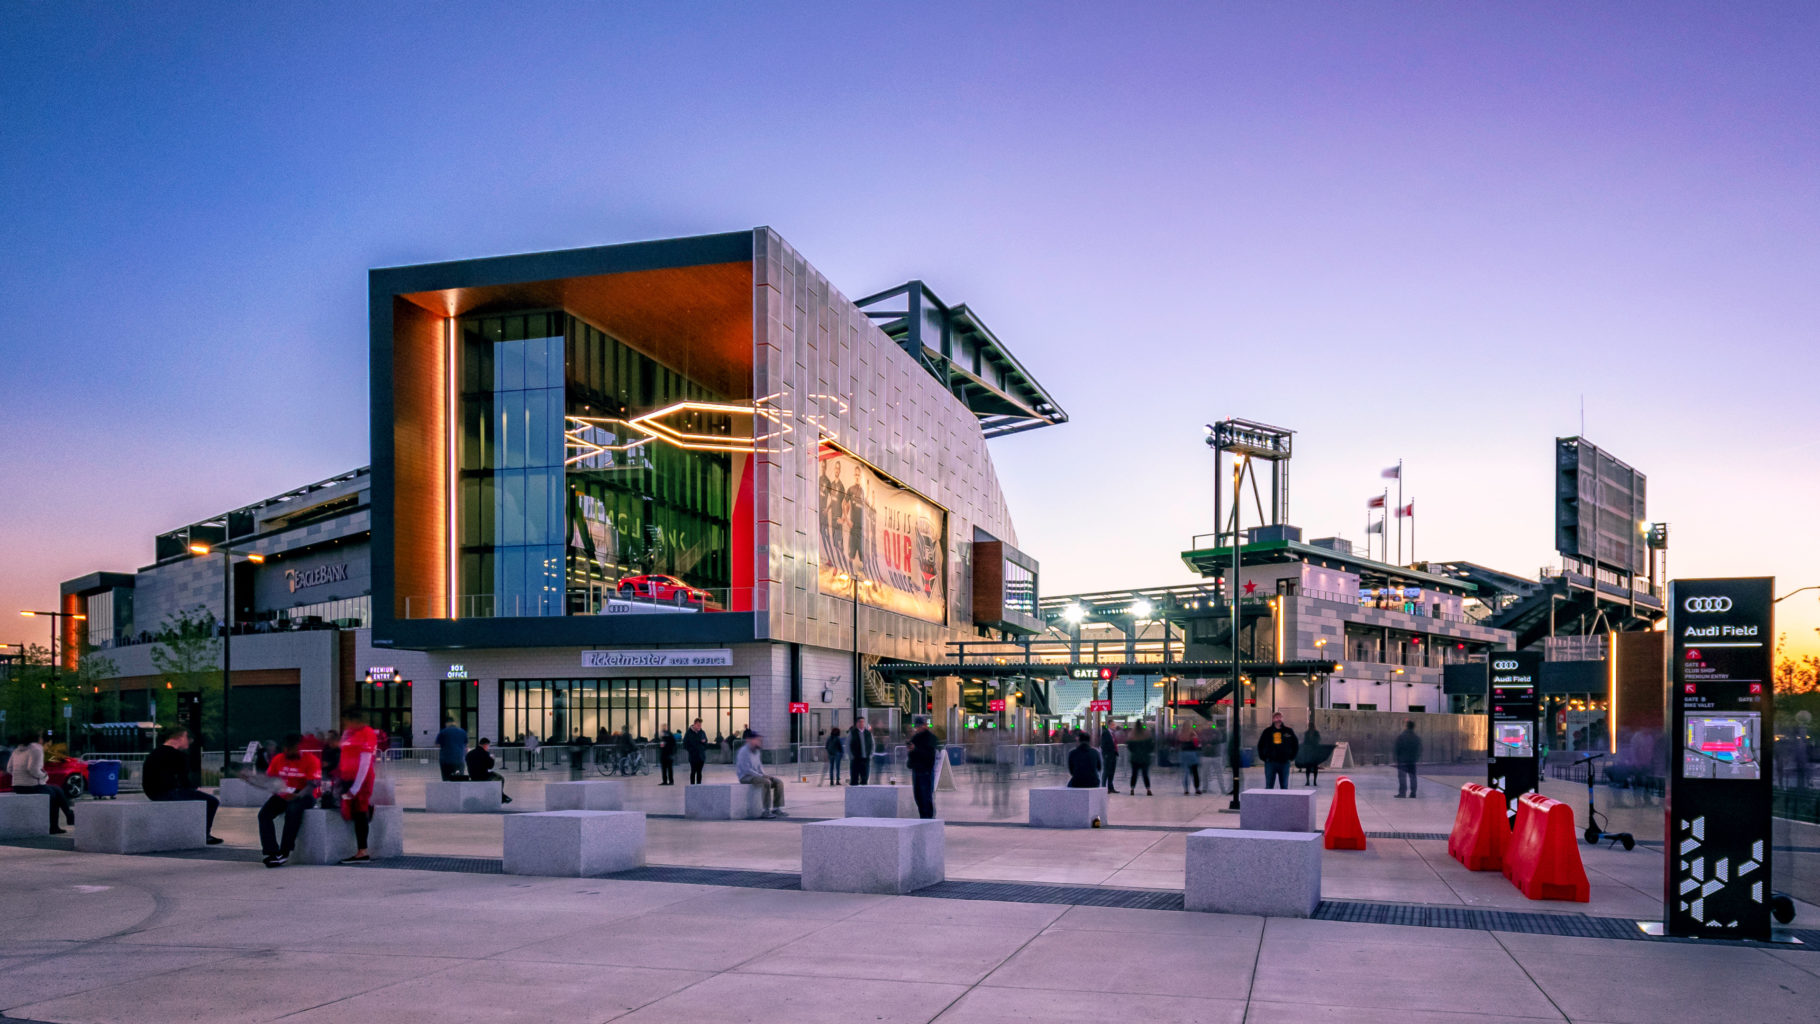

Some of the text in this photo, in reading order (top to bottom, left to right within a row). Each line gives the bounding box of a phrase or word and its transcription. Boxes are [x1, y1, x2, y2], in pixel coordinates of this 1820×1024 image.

[884, 506, 911, 534] THIS IS
[883, 529, 912, 573] OUR
[1684, 625, 1759, 637] Audi Field
[590, 653, 667, 666] ticketmaster
[692, 656, 726, 665] OFFICE
[447, 671, 468, 679] OFFICE
[1073, 669, 1099, 678] GATE
